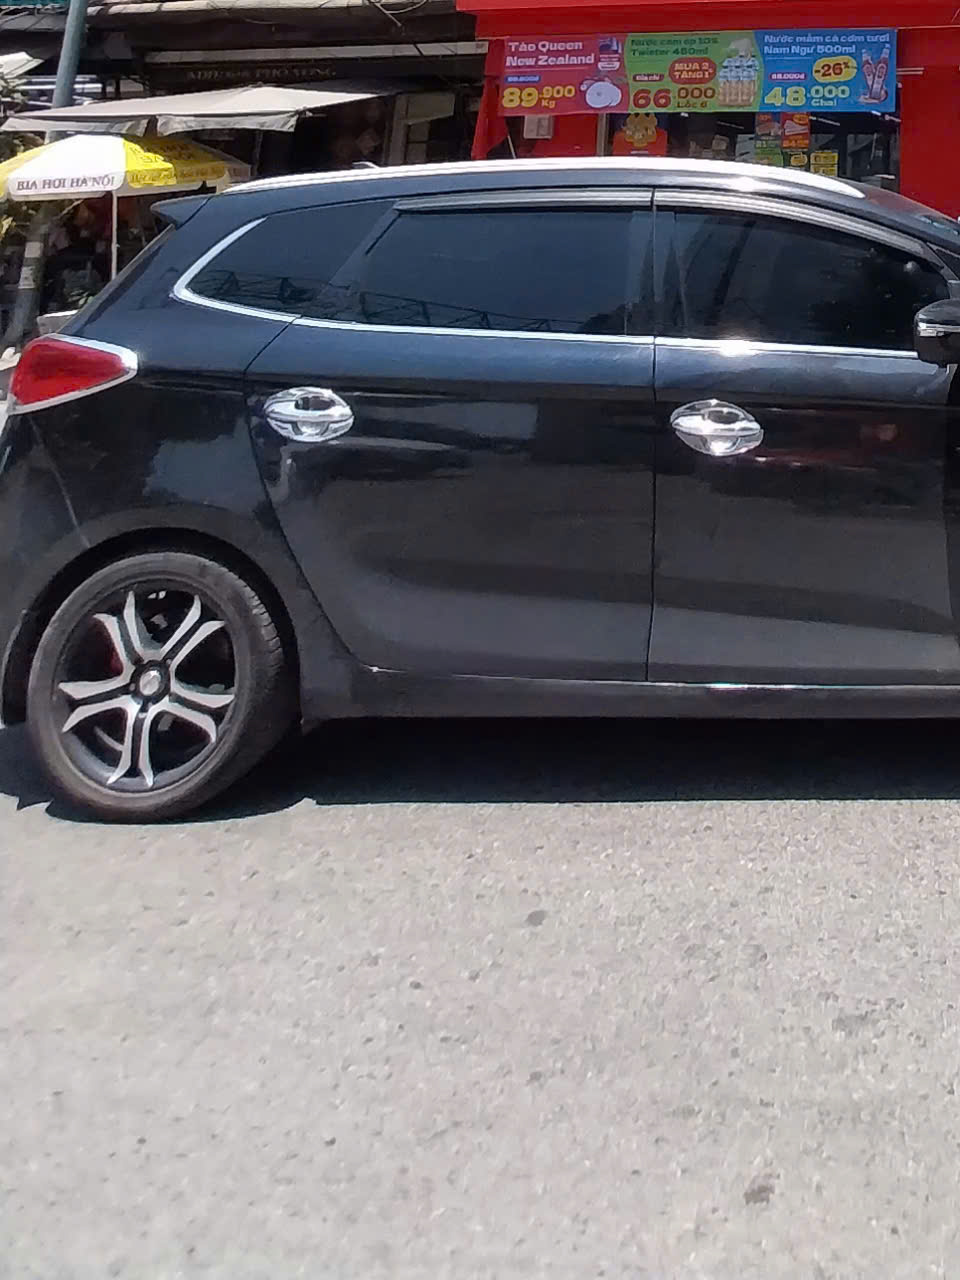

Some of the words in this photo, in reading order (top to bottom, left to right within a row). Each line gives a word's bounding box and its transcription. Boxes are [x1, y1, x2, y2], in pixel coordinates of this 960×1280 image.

[764, 34, 793, 43] Nước
[825, 33, 838, 43] cá
[763, 45, 790, 55] Nam
[791, 45, 815, 56] Ngư
[816, 44, 856, 54] 500ml
[505, 56, 537, 67] New
[537, 53, 596, 66] Zealand
[674, 62, 700, 71] MUA
[541, 99, 557, 109] Kg
[16, 180, 38, 191] BIA
[42, 177, 67, 190] HƠI
[70, 176, 89, 188] HÀ
[91, 174, 115, 188] NỘI
